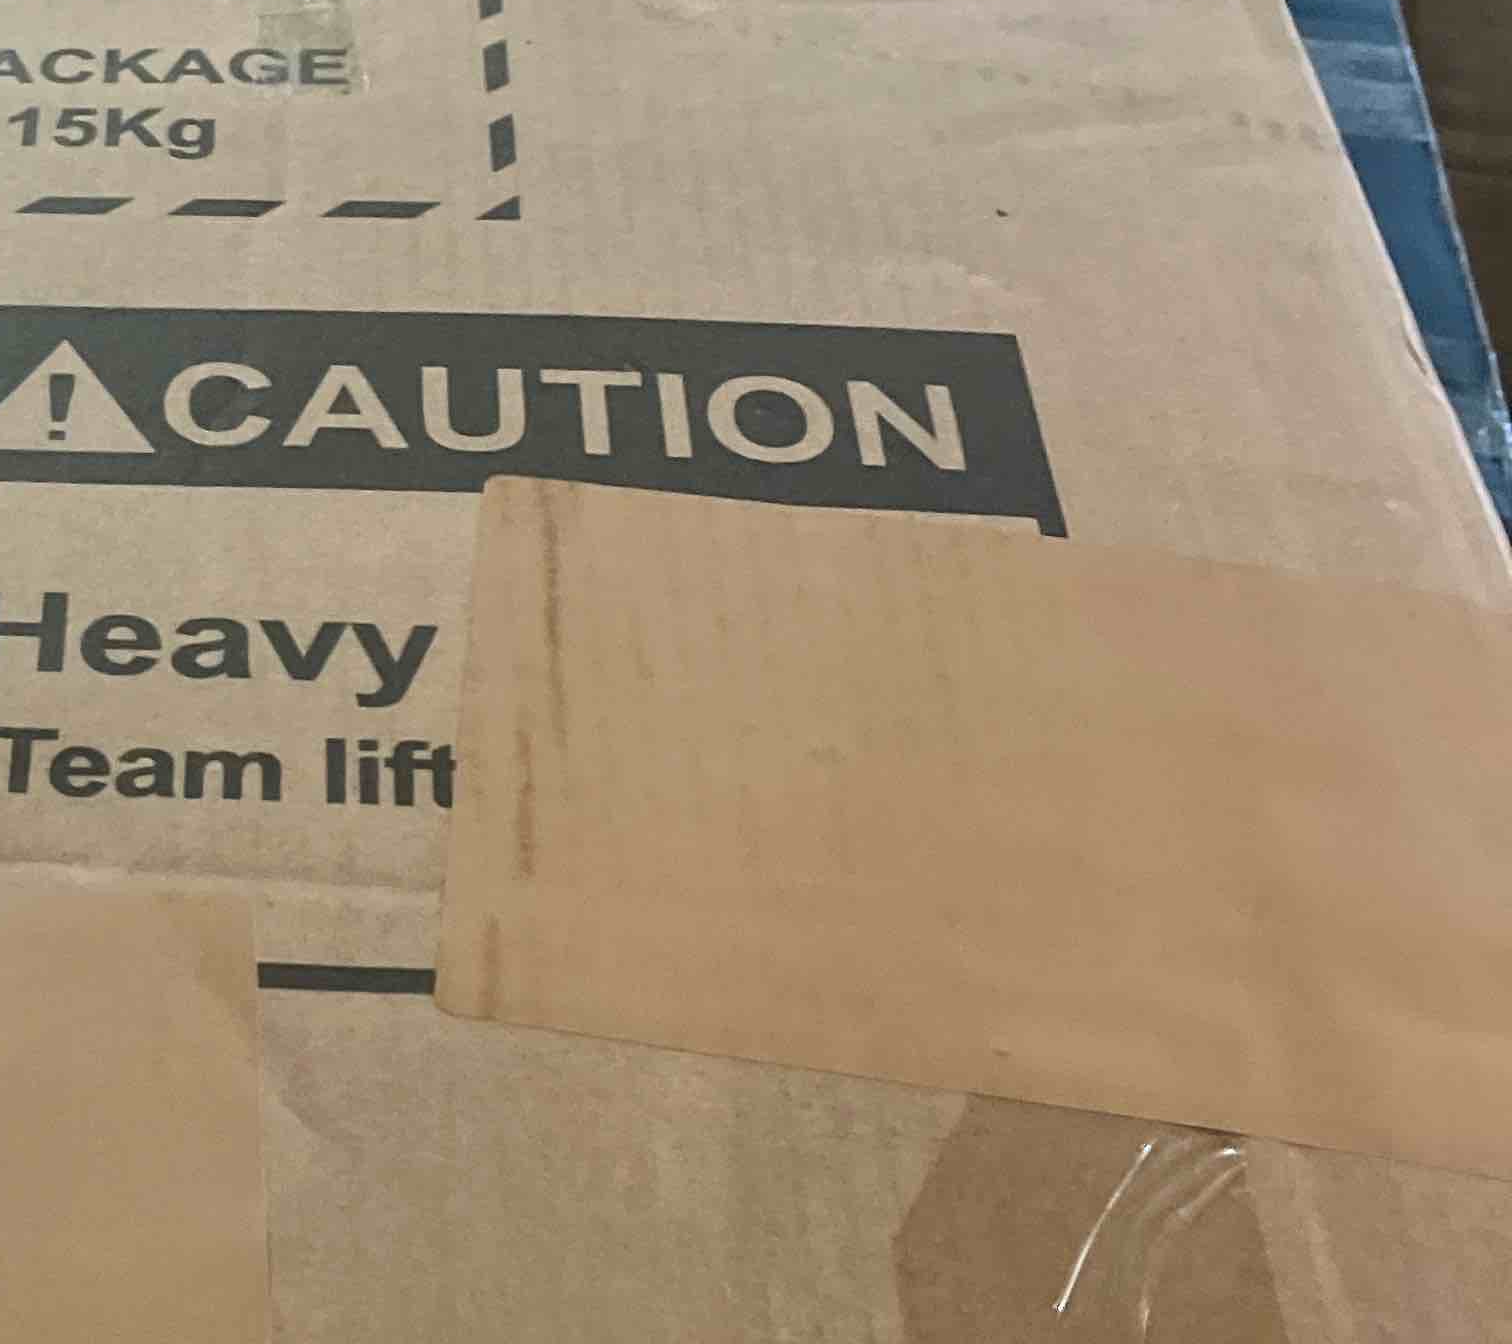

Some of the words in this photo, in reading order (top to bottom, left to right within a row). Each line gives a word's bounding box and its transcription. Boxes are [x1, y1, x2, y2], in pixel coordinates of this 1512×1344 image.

[11, 107, 218, 161] 15Kg
[162, 360, 968, 473] CAUTION
[325, 737, 457, 809] lift
